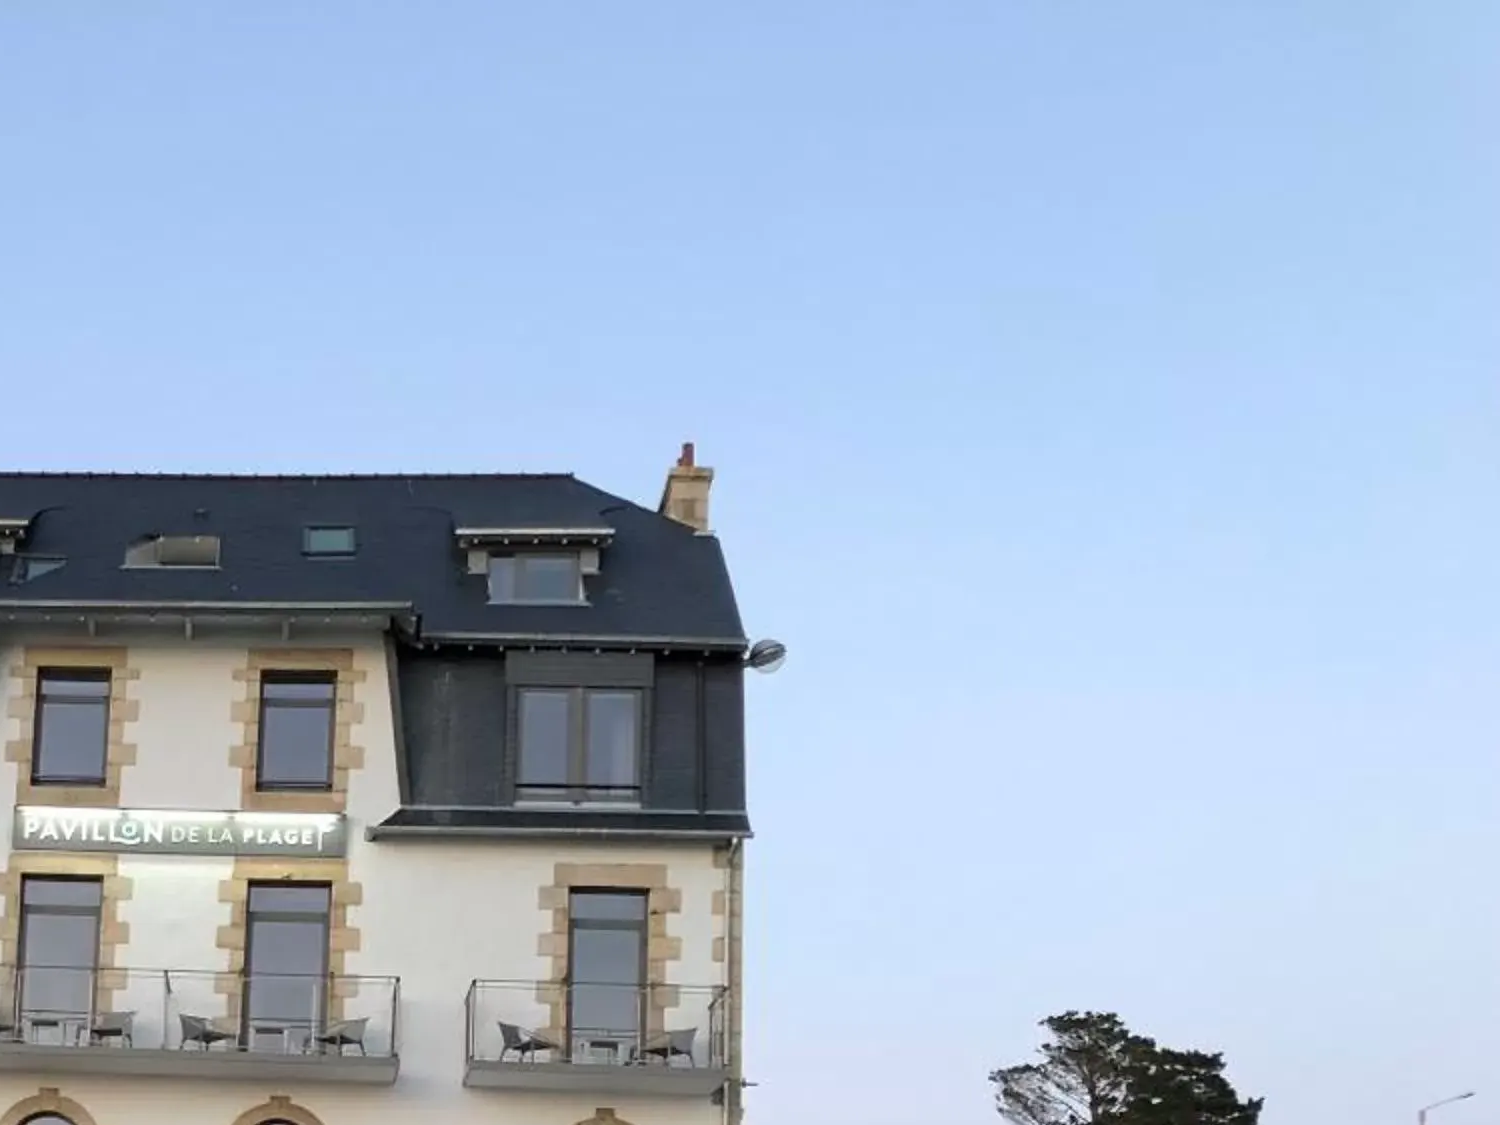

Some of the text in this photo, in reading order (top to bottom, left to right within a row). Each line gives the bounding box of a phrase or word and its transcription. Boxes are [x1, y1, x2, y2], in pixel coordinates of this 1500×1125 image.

[23, 817, 313, 846] PAVILLON DE LA PLAGE
